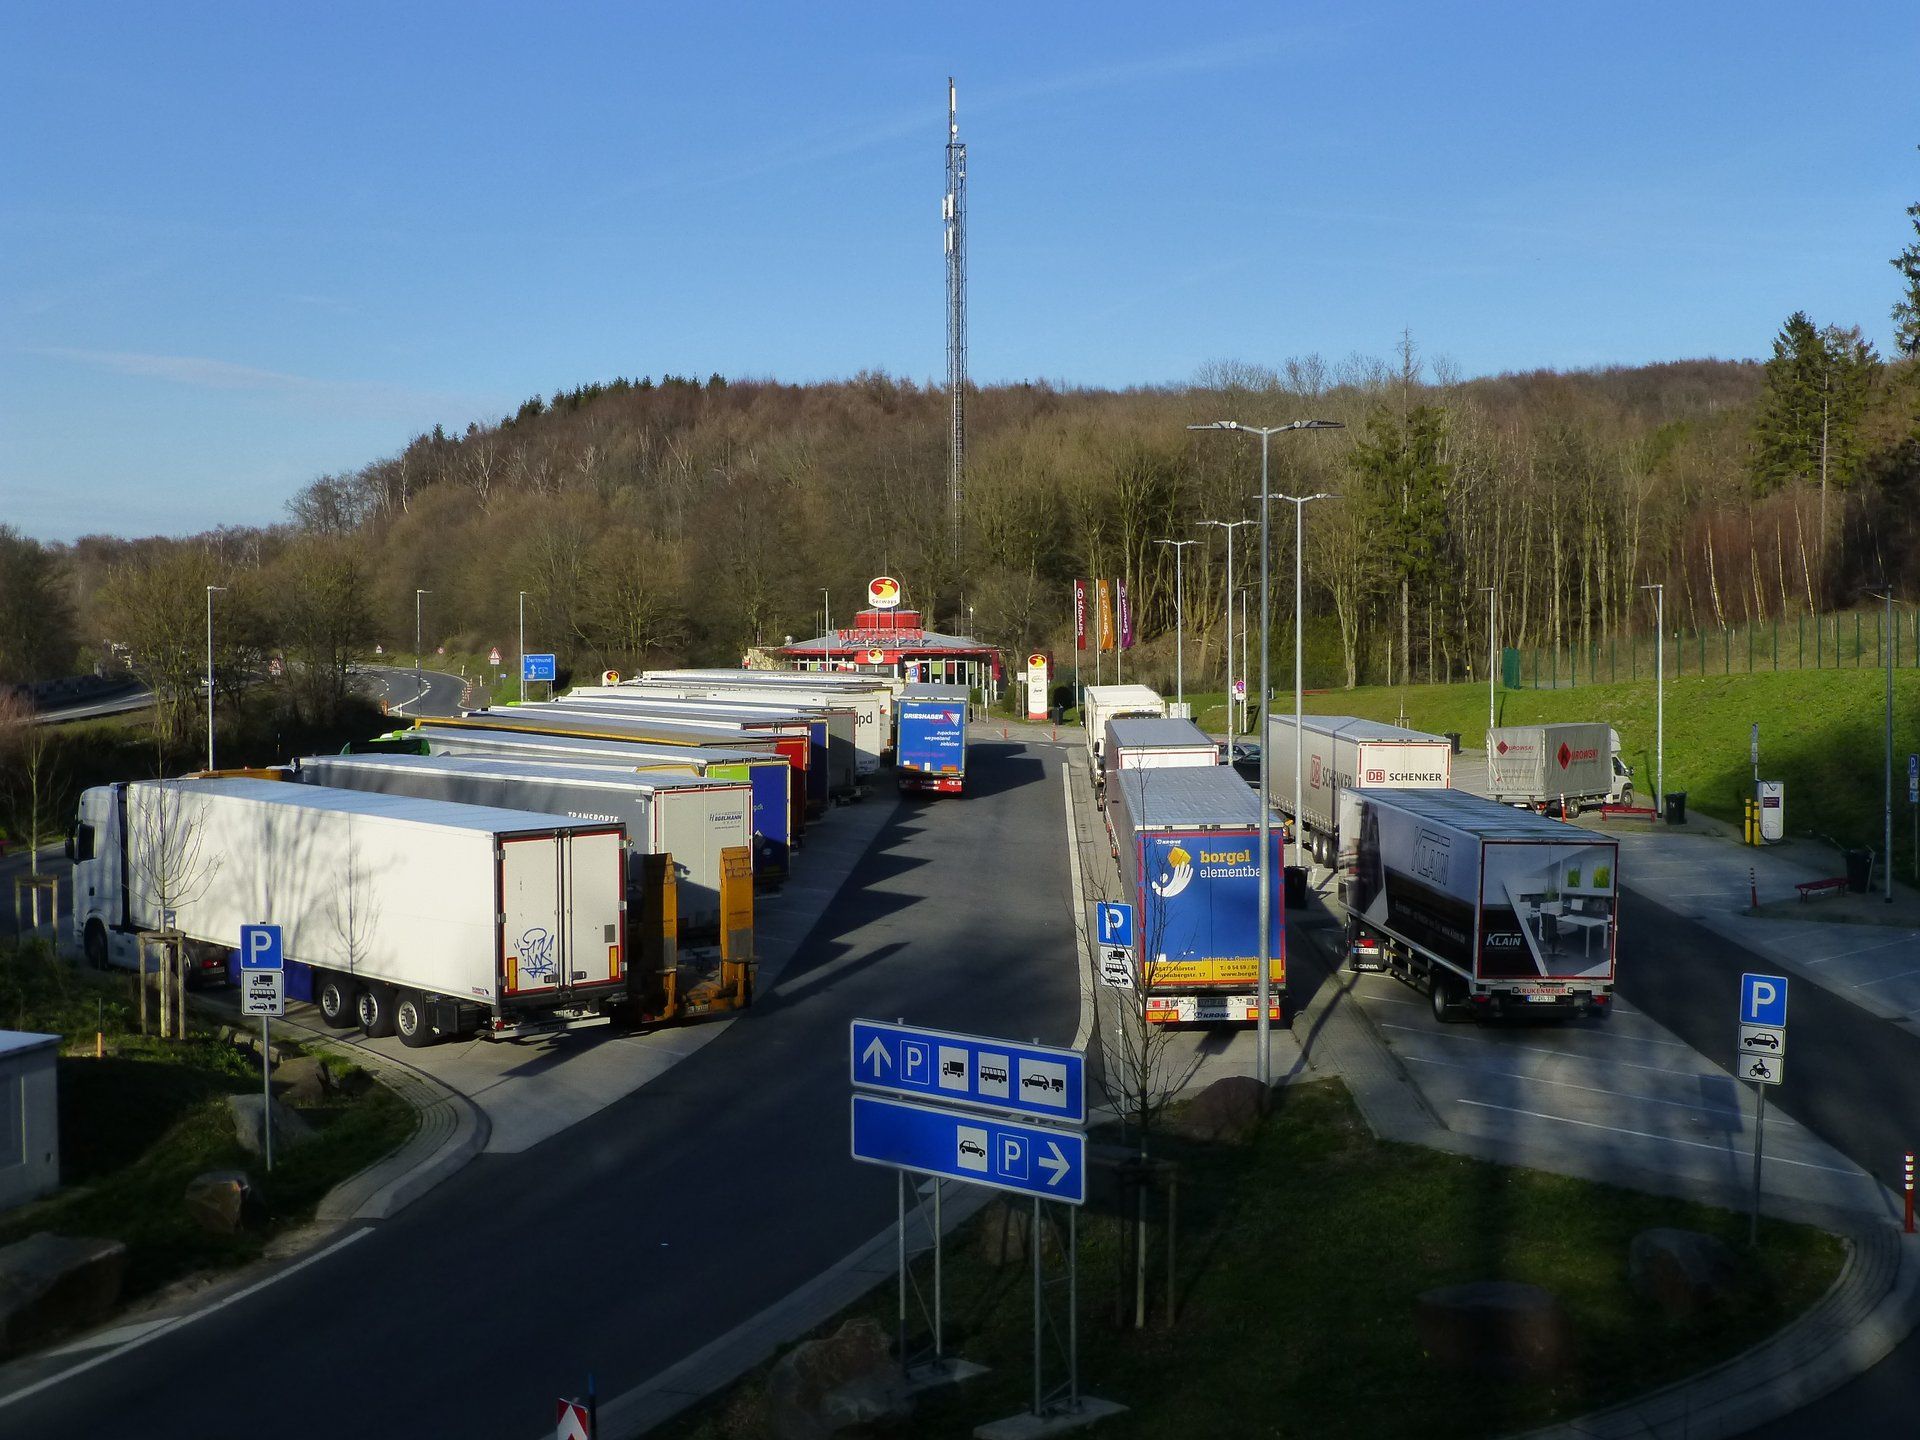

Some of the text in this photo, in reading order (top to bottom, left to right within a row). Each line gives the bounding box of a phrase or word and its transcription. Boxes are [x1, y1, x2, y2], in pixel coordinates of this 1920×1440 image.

[1368, 771, 1442, 782] DB SCHENKER
[1200, 849, 1251, 866] borgel
[1105, 908, 1124, 940] P
[1486, 933, 1522, 946] KLAIN
[250, 930, 272, 964] P
[1751, 981, 1776, 1018] P
[906, 1046, 923, 1077] P
[1004, 1139, 1021, 1171] P
